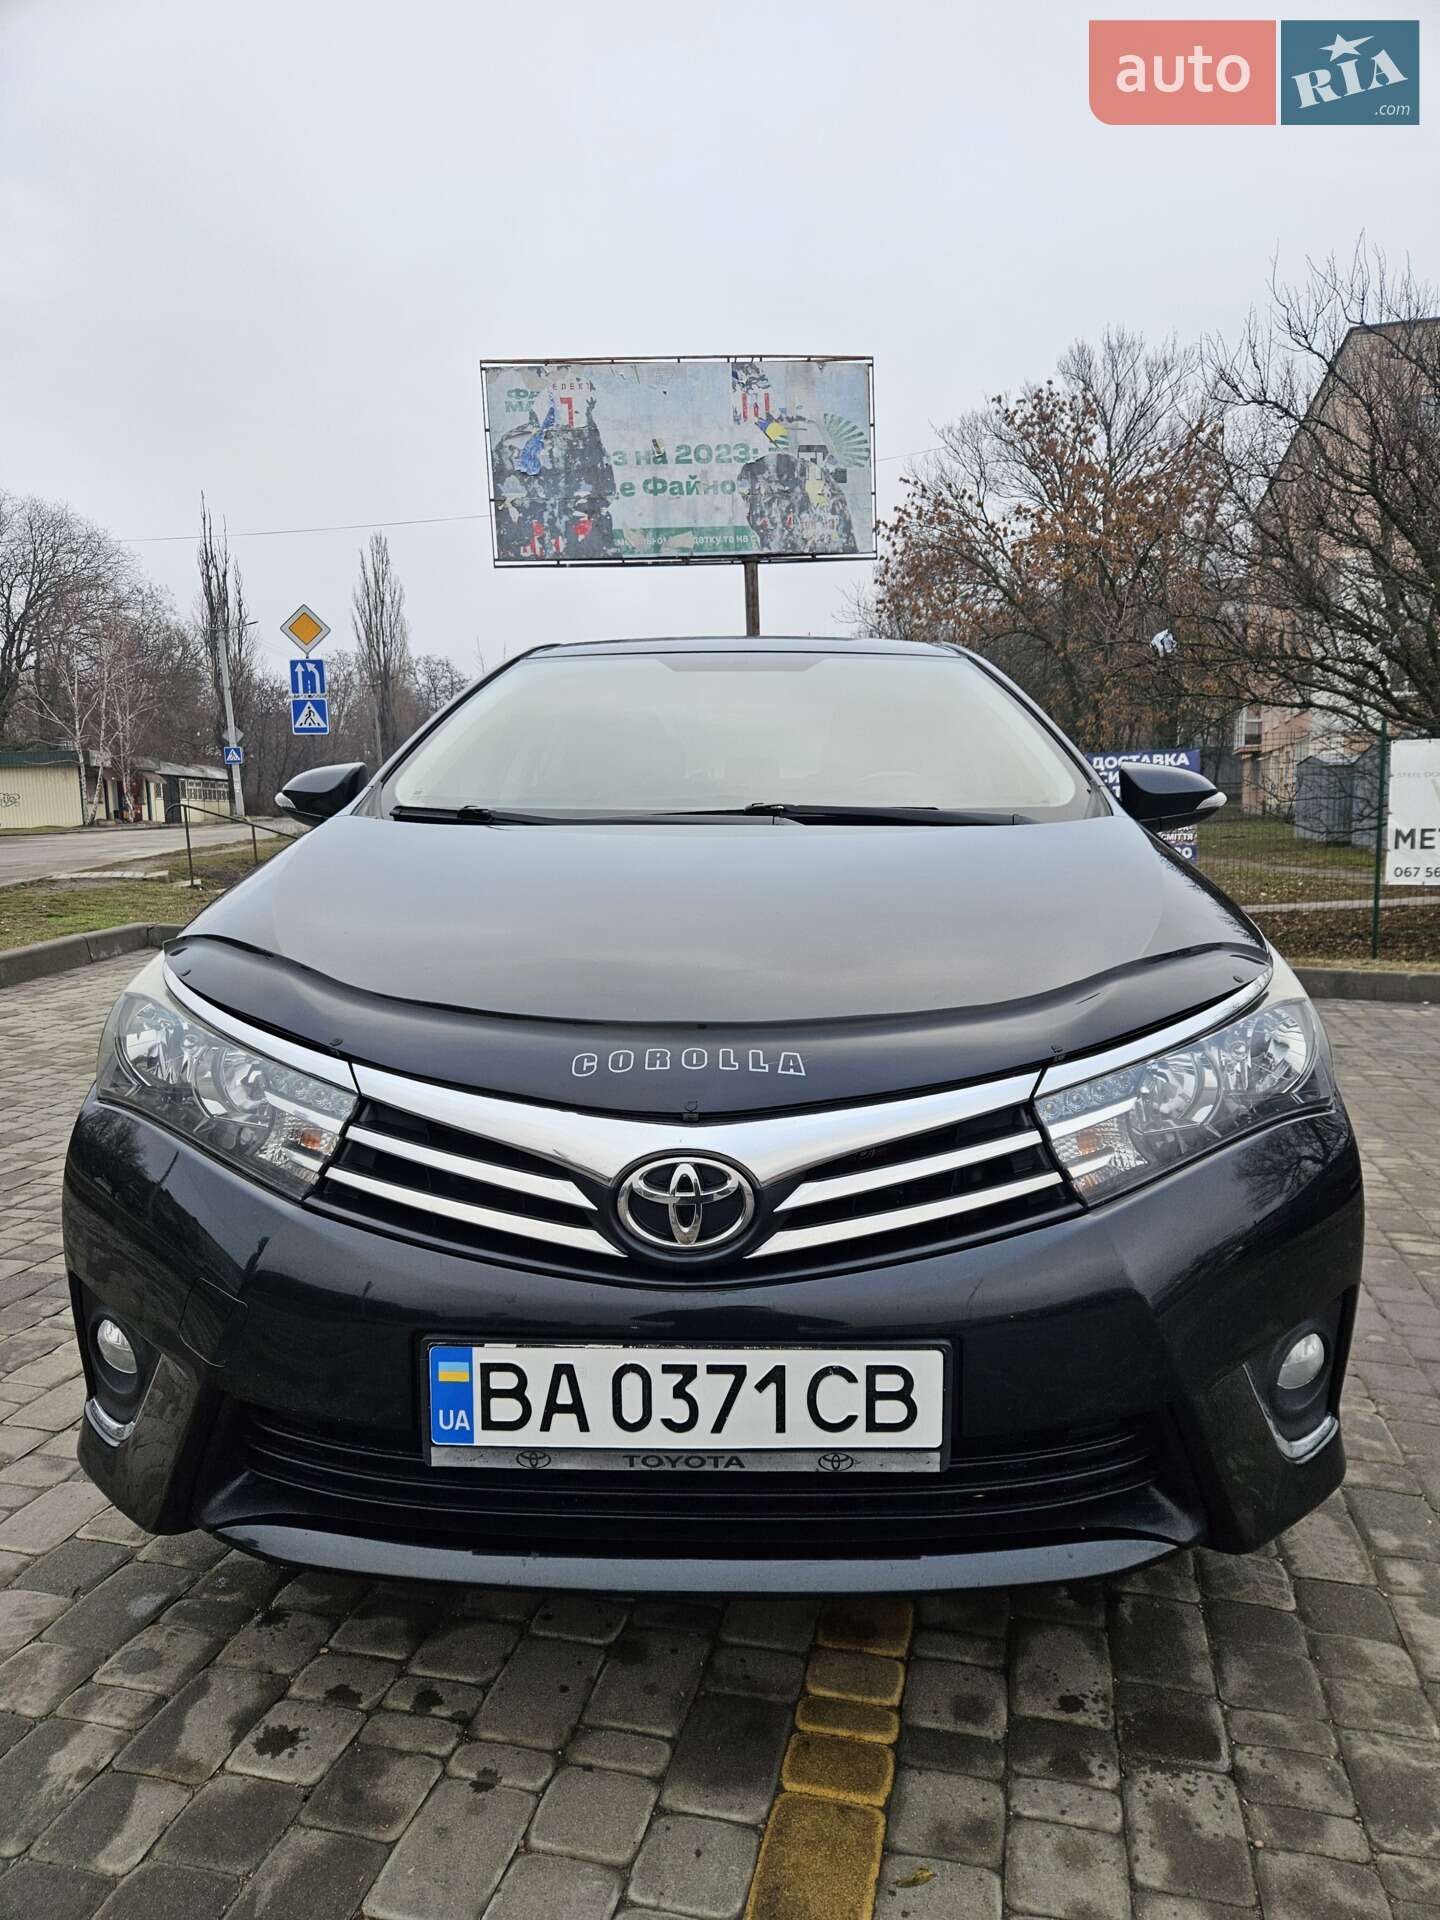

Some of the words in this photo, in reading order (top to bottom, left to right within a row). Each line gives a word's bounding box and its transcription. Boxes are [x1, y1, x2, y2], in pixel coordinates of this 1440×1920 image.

[642, 474, 736, 497] Файно
[1394, 867, 1420, 878] 067
[571, 1048, 806, 1077] COROLLA
[480, 1362, 590, 1432] BA
[611, 1363, 786, 1434] 0371
[806, 1364, 919, 1433] CB
[438, 1409, 471, 1431] UA
[622, 1454, 746, 1469] TOYOTA
